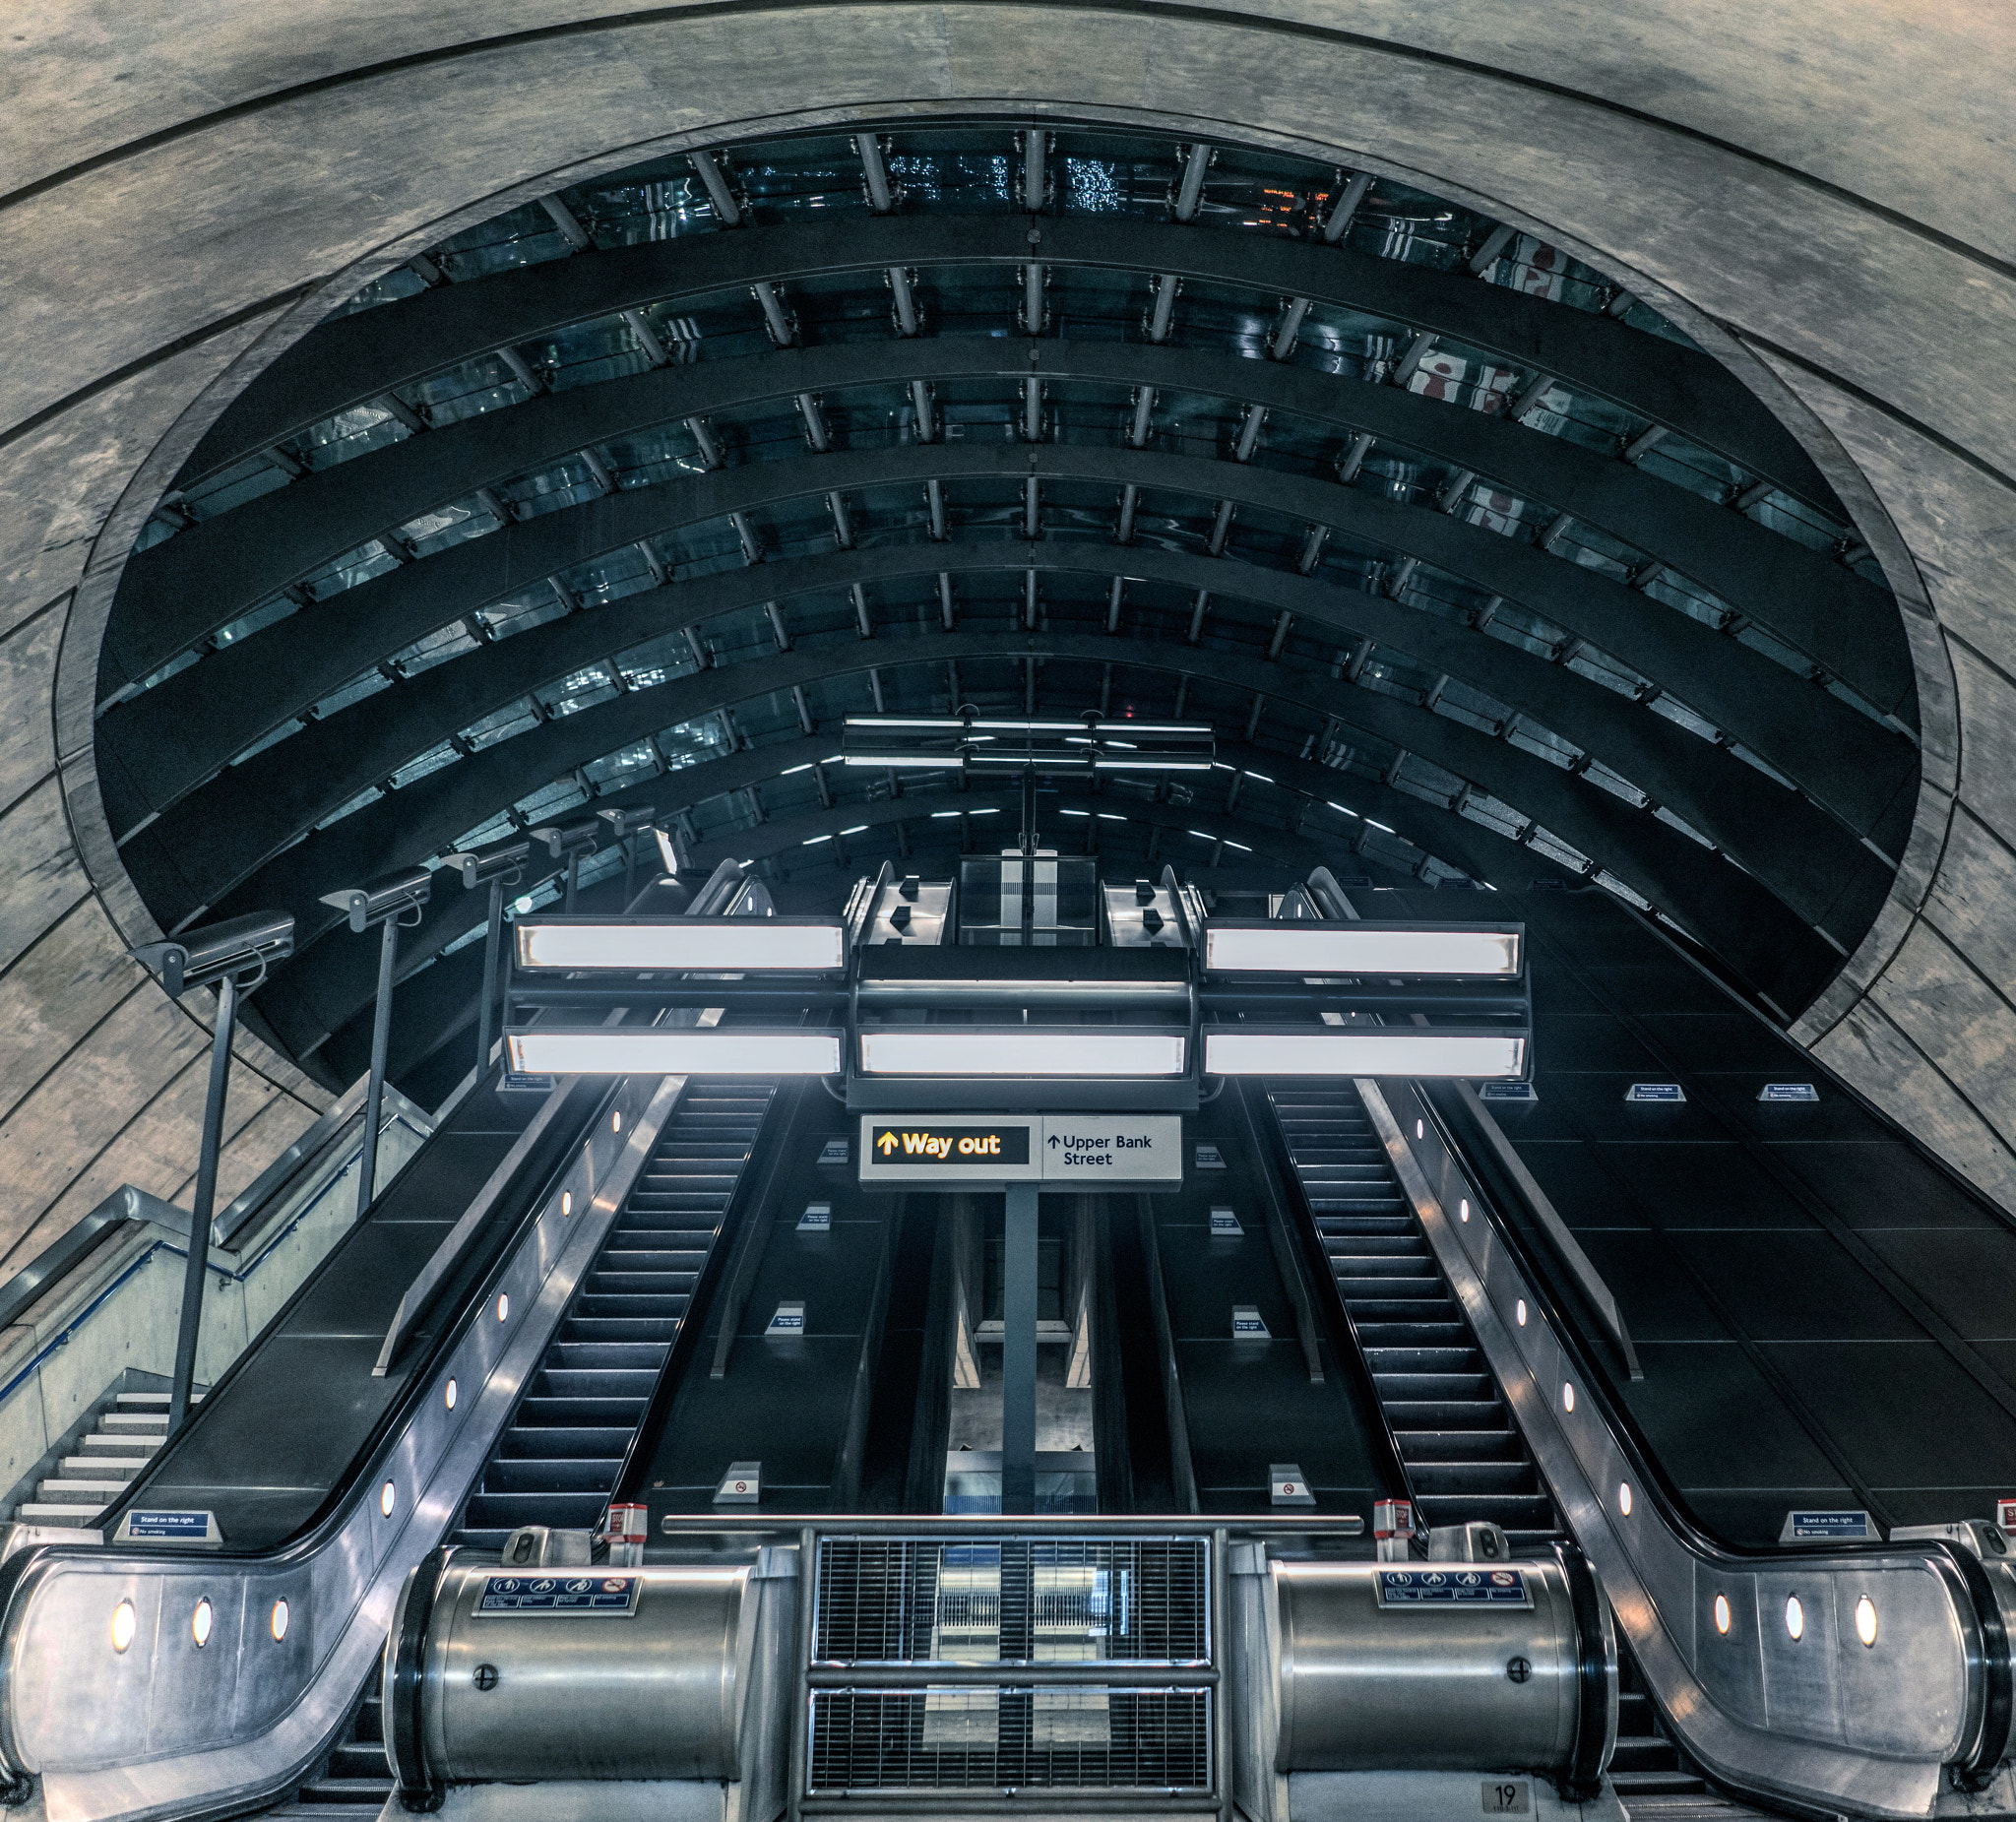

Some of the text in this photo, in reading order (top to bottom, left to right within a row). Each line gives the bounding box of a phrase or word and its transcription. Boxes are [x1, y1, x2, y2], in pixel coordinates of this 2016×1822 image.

[902, 1133, 1001, 1159] Way out
[1063, 1135, 1152, 1151] Upper Bank
[1064, 1152, 1112, 1165] Street
[1495, 1785, 1516, 1805] 19
